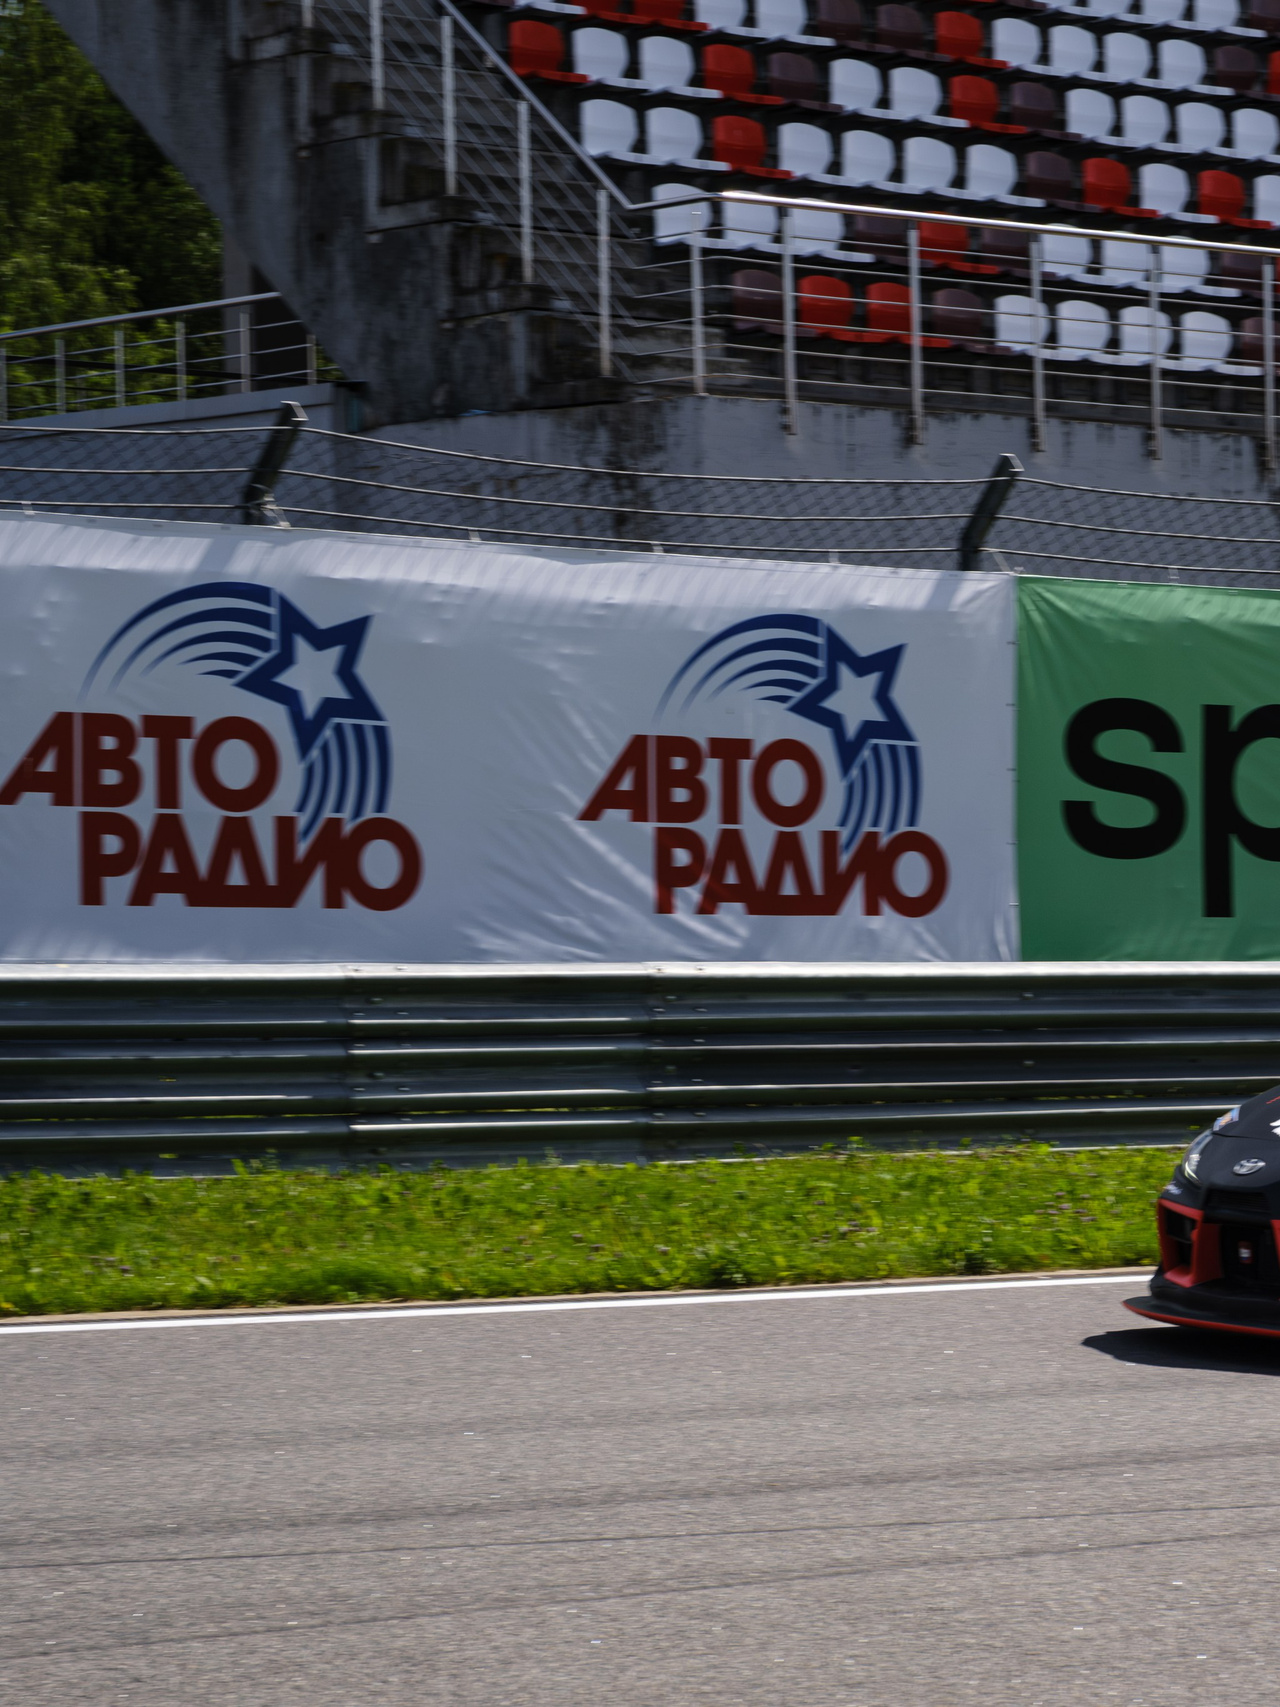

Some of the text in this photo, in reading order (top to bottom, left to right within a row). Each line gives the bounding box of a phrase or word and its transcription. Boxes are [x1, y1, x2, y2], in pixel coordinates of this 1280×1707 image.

[0, 711, 281, 813] АВТО
[577, 734, 825, 827] АВТО
[79, 811, 425, 911] РАДИО
[653, 827, 950, 918] РАДИО
